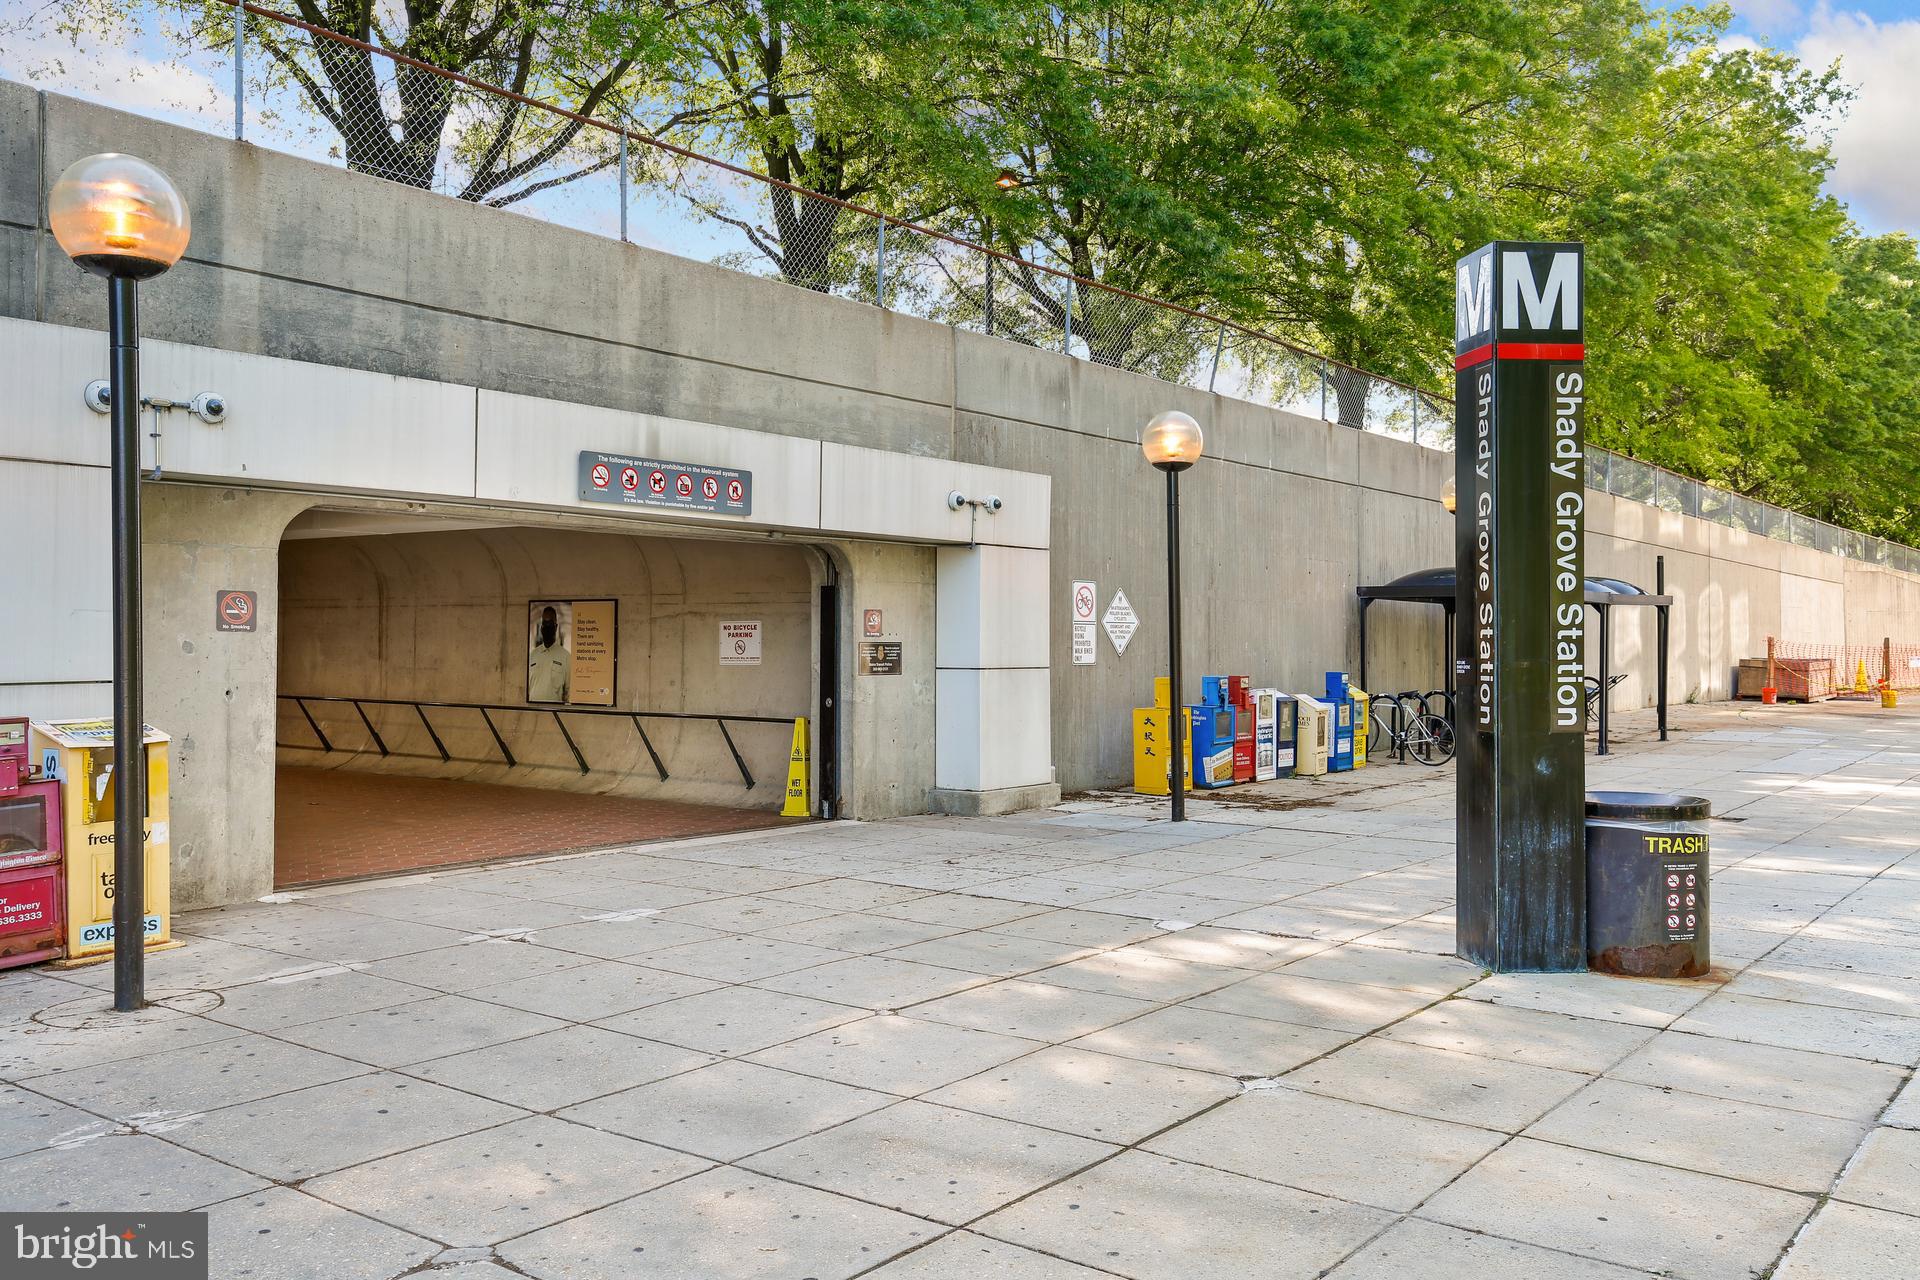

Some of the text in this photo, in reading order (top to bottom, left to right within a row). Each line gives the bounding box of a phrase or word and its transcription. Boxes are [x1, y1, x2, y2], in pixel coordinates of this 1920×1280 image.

[1458, 253, 1490, 342] M
[1503, 251, 1578, 330] M
[609, 457, 633, 466] following
[643, 460, 660, 469] strictly
[661, 463, 686, 472] prohibited
[701, 468, 722, 476] Metrorail
[1476, 372, 1494, 725] Shady Grove Station
[1551, 372, 1583, 726] Shady Grove Station
[791, 778, 801, 787] WET
[789, 789, 802, 797] FLOOR
[1644, 836, 1702, 854] TRASH
[4, 901, 41, 914] Delivery
